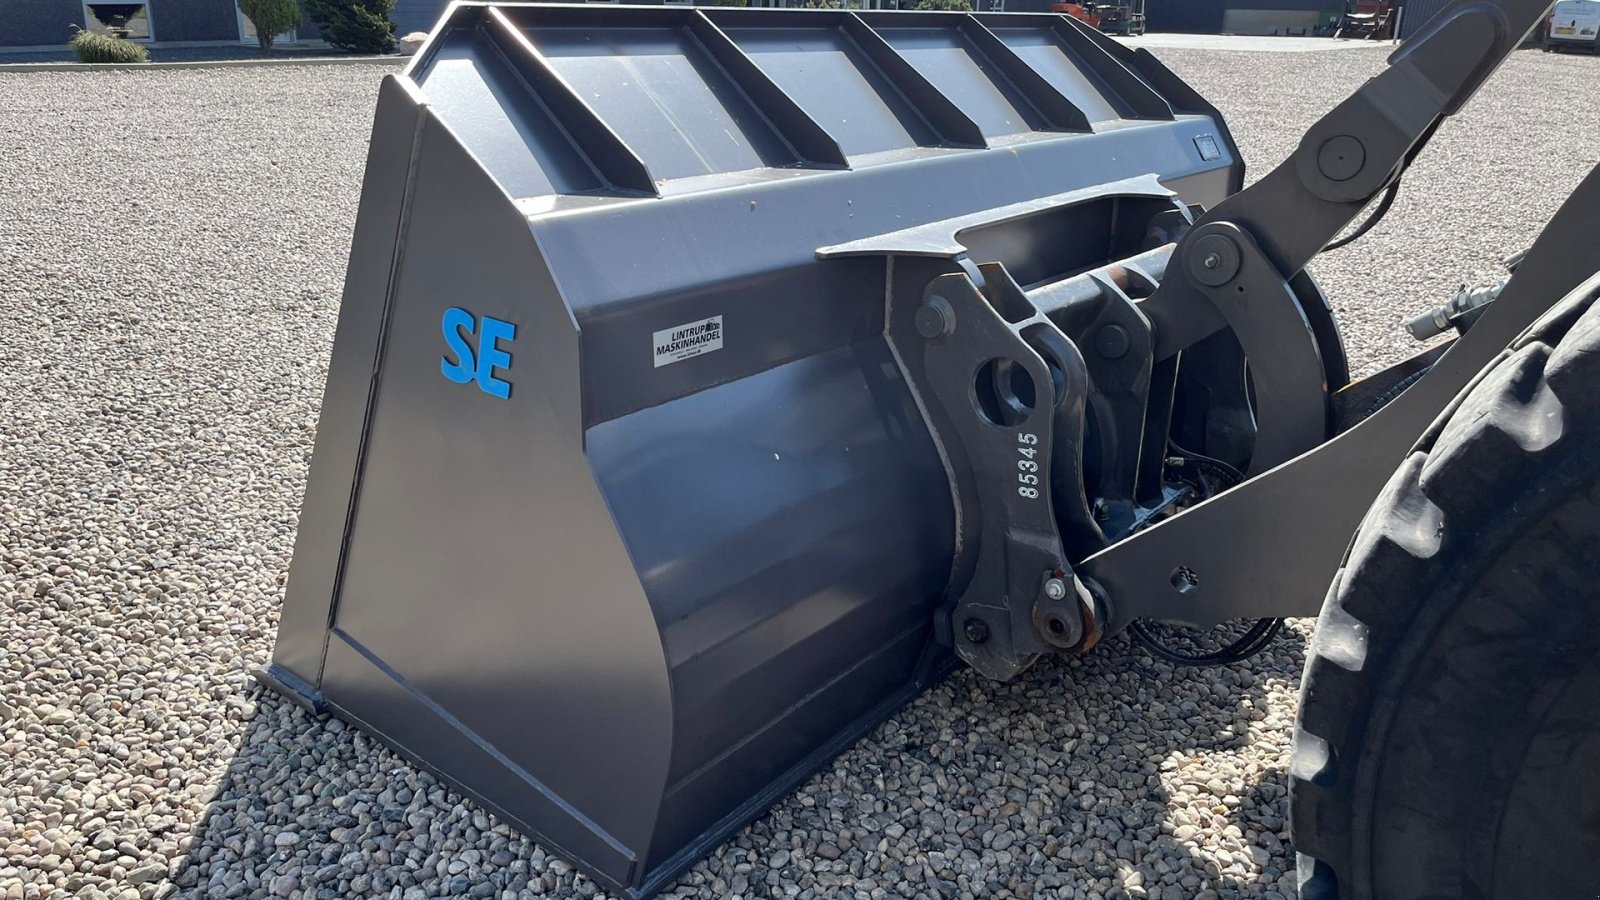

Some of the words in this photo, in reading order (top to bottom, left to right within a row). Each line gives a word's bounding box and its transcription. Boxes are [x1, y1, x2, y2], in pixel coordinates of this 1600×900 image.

[441, 307, 516, 399] SE
[656, 330, 721, 356] MASKINHANDEL
[672, 324, 706, 341] LINTRUP
[1017, 433, 1039, 499] 85345
